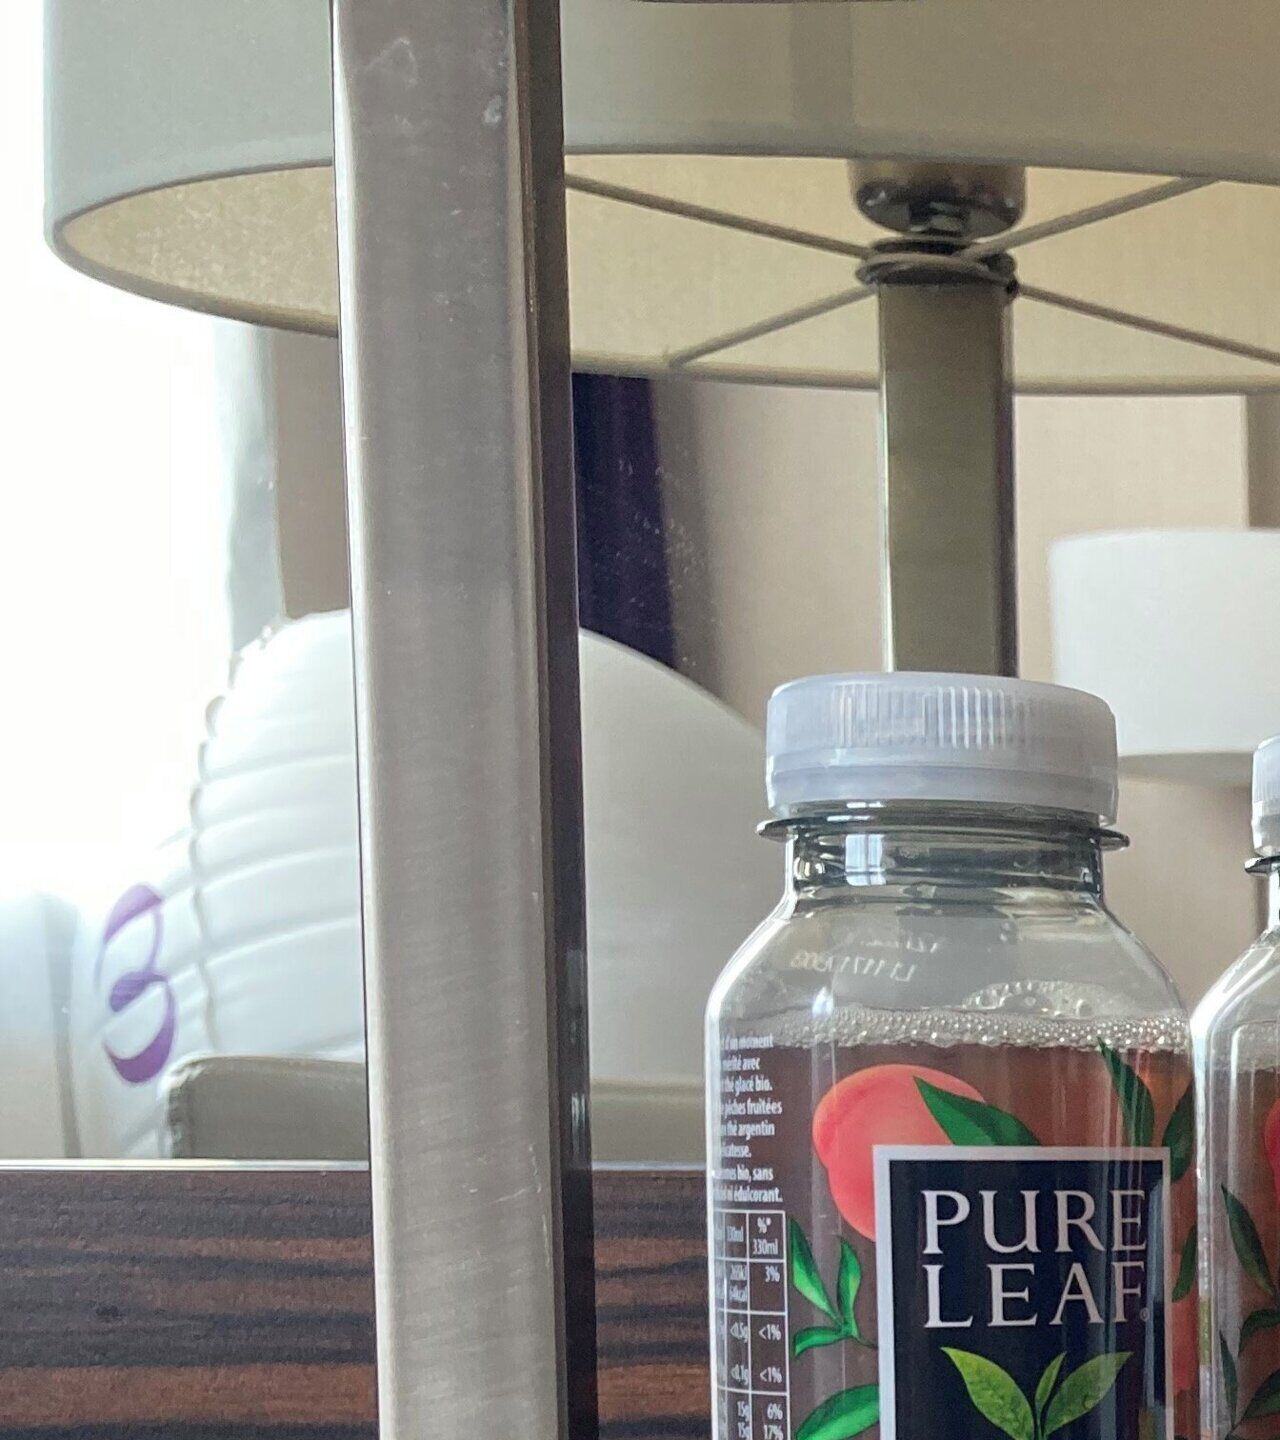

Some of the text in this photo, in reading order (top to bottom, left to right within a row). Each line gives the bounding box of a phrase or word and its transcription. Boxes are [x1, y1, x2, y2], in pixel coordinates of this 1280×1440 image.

[747, 1097, 783, 1115] fruitées
[738, 1120, 775, 1140] argentin
[752, 1167, 774, 1182] sans
[921, 1189, 1147, 1255] PURE
[752, 1238, 779, 1256] 330ml
[765, 1265, 781, 1282] 3%
[923, 1261, 1146, 1329] LEAF
[758, 1323, 782, 1341] <1%
[759, 1366, 783, 1383] <1%
[767, 1402, 783, 1420] 6%
